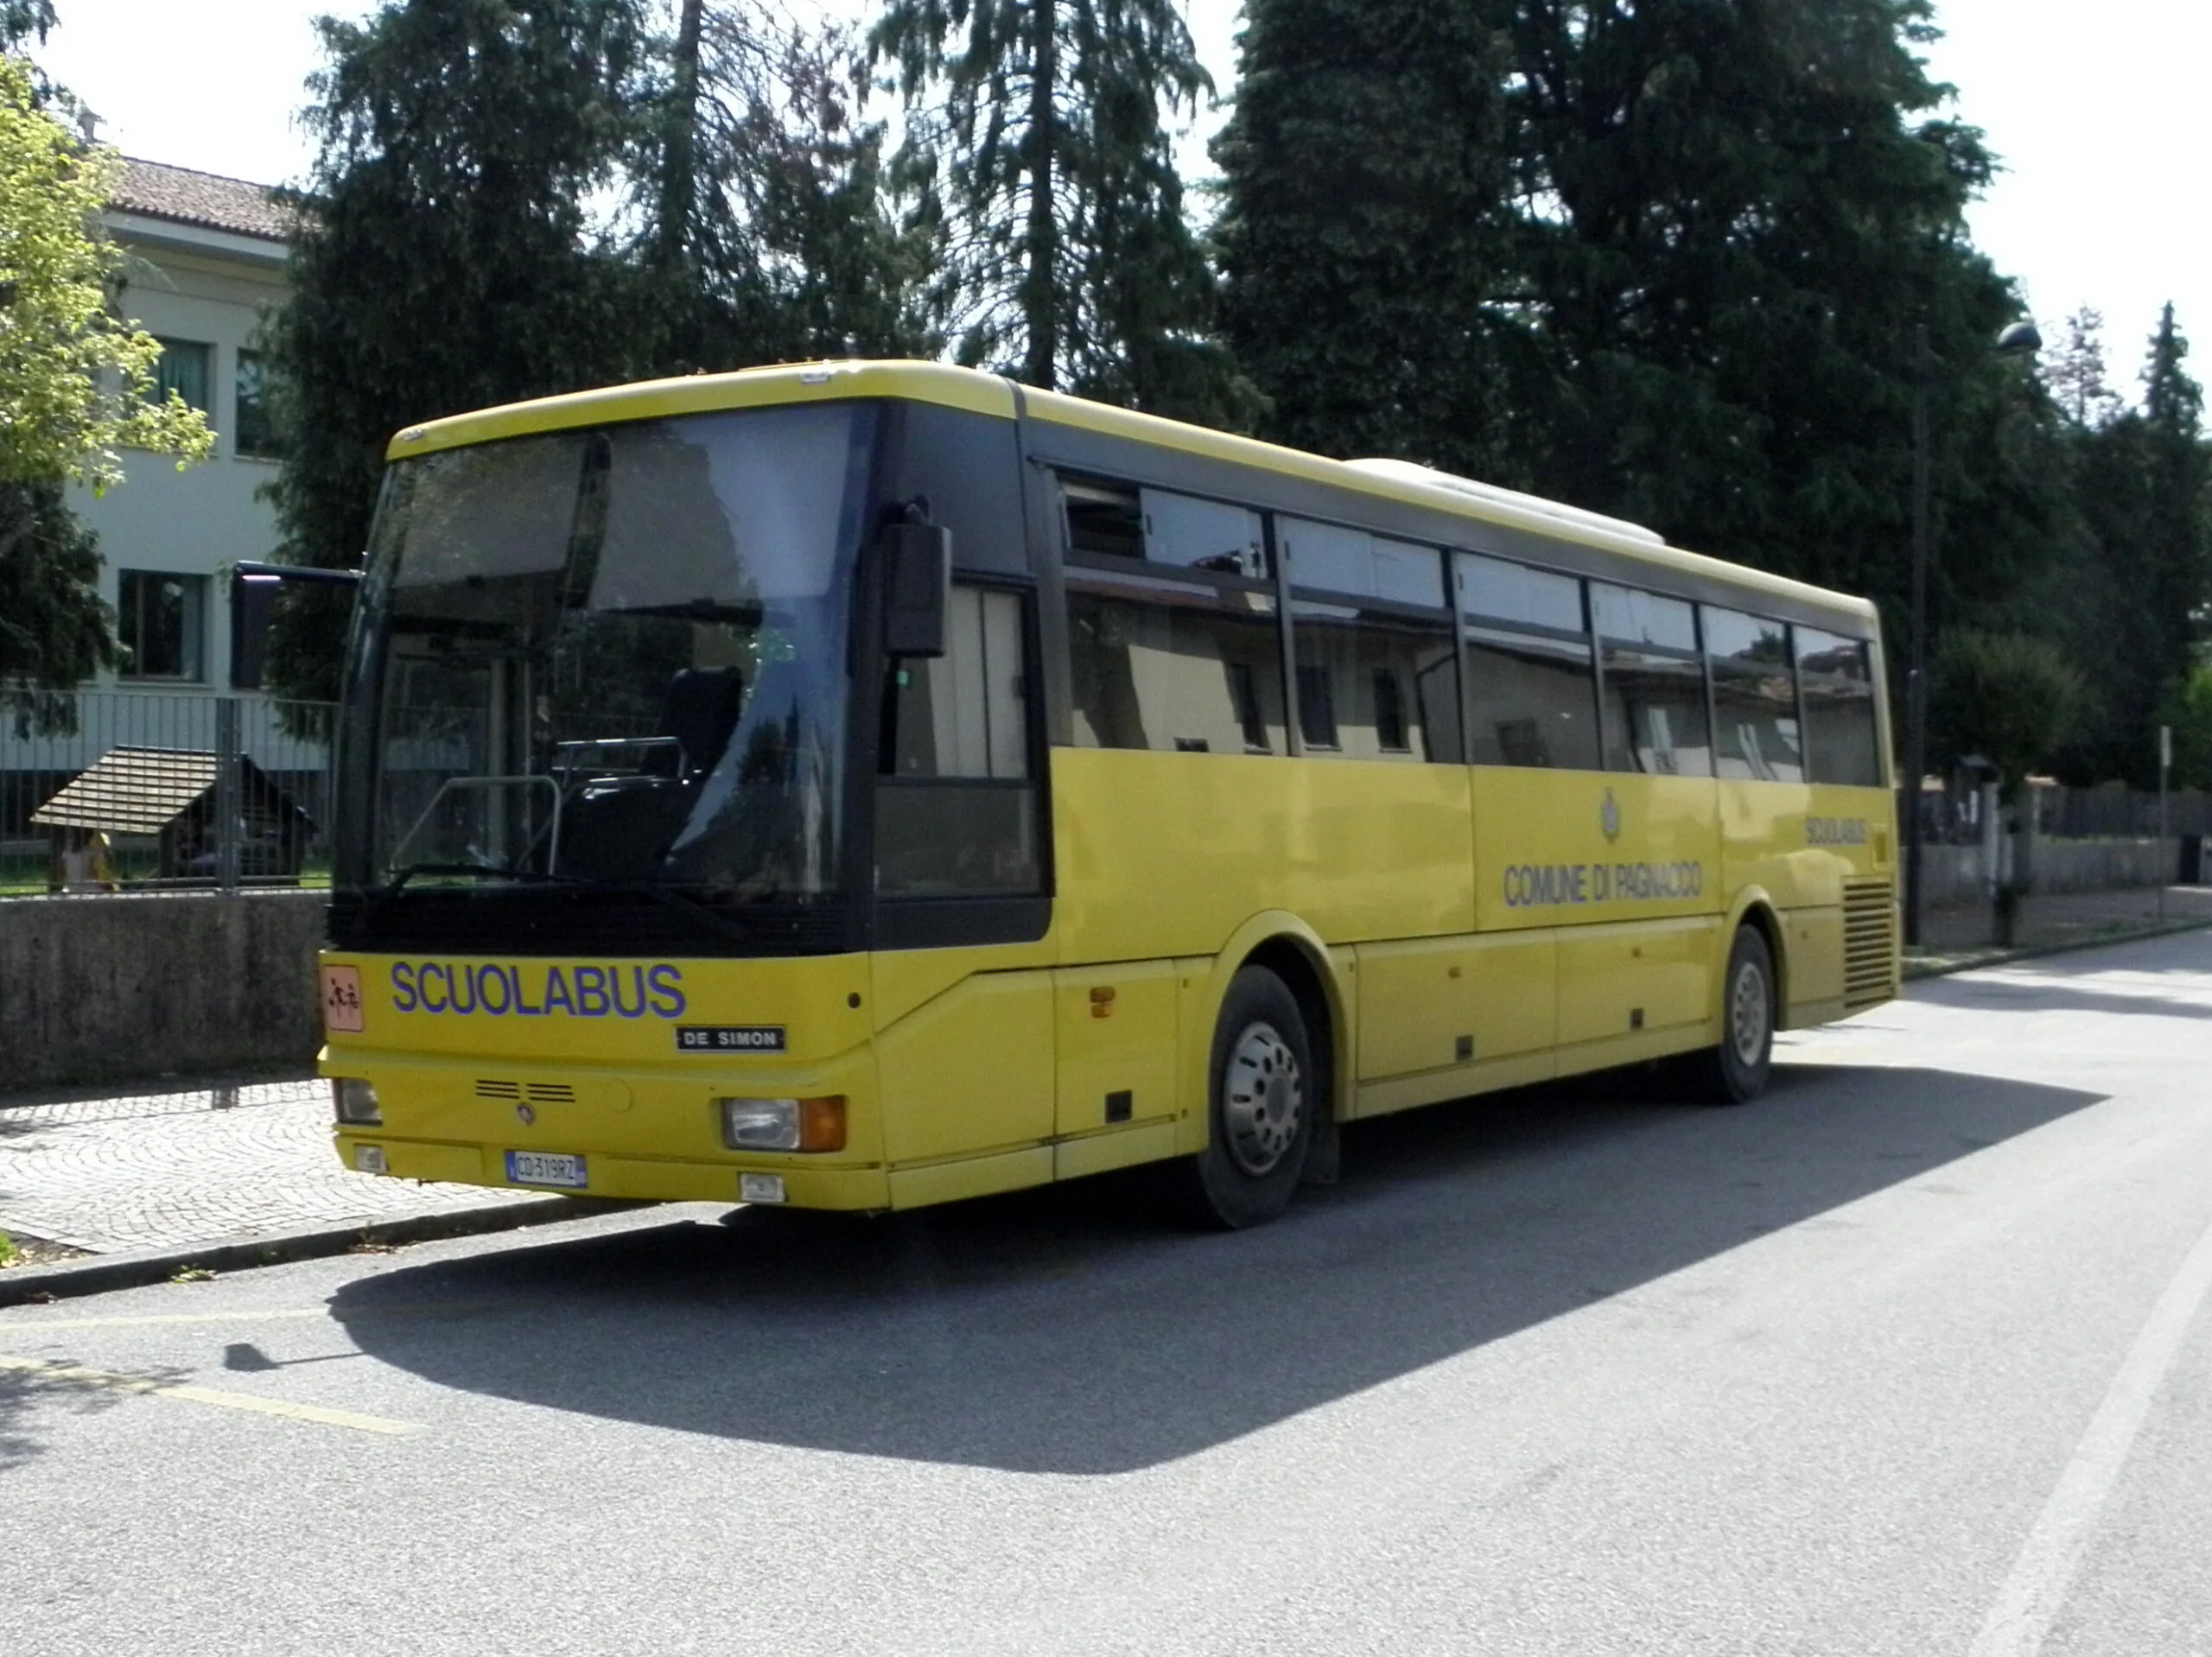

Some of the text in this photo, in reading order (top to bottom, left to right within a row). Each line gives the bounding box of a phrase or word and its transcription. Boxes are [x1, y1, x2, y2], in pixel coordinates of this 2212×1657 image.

[1503, 864, 1587, 907] COMUNE
[1592, 862, 1611, 901] DI
[391, 961, 686, 1019] SCUOLABUS
[683, 1032, 777, 1045] DE SIMON
